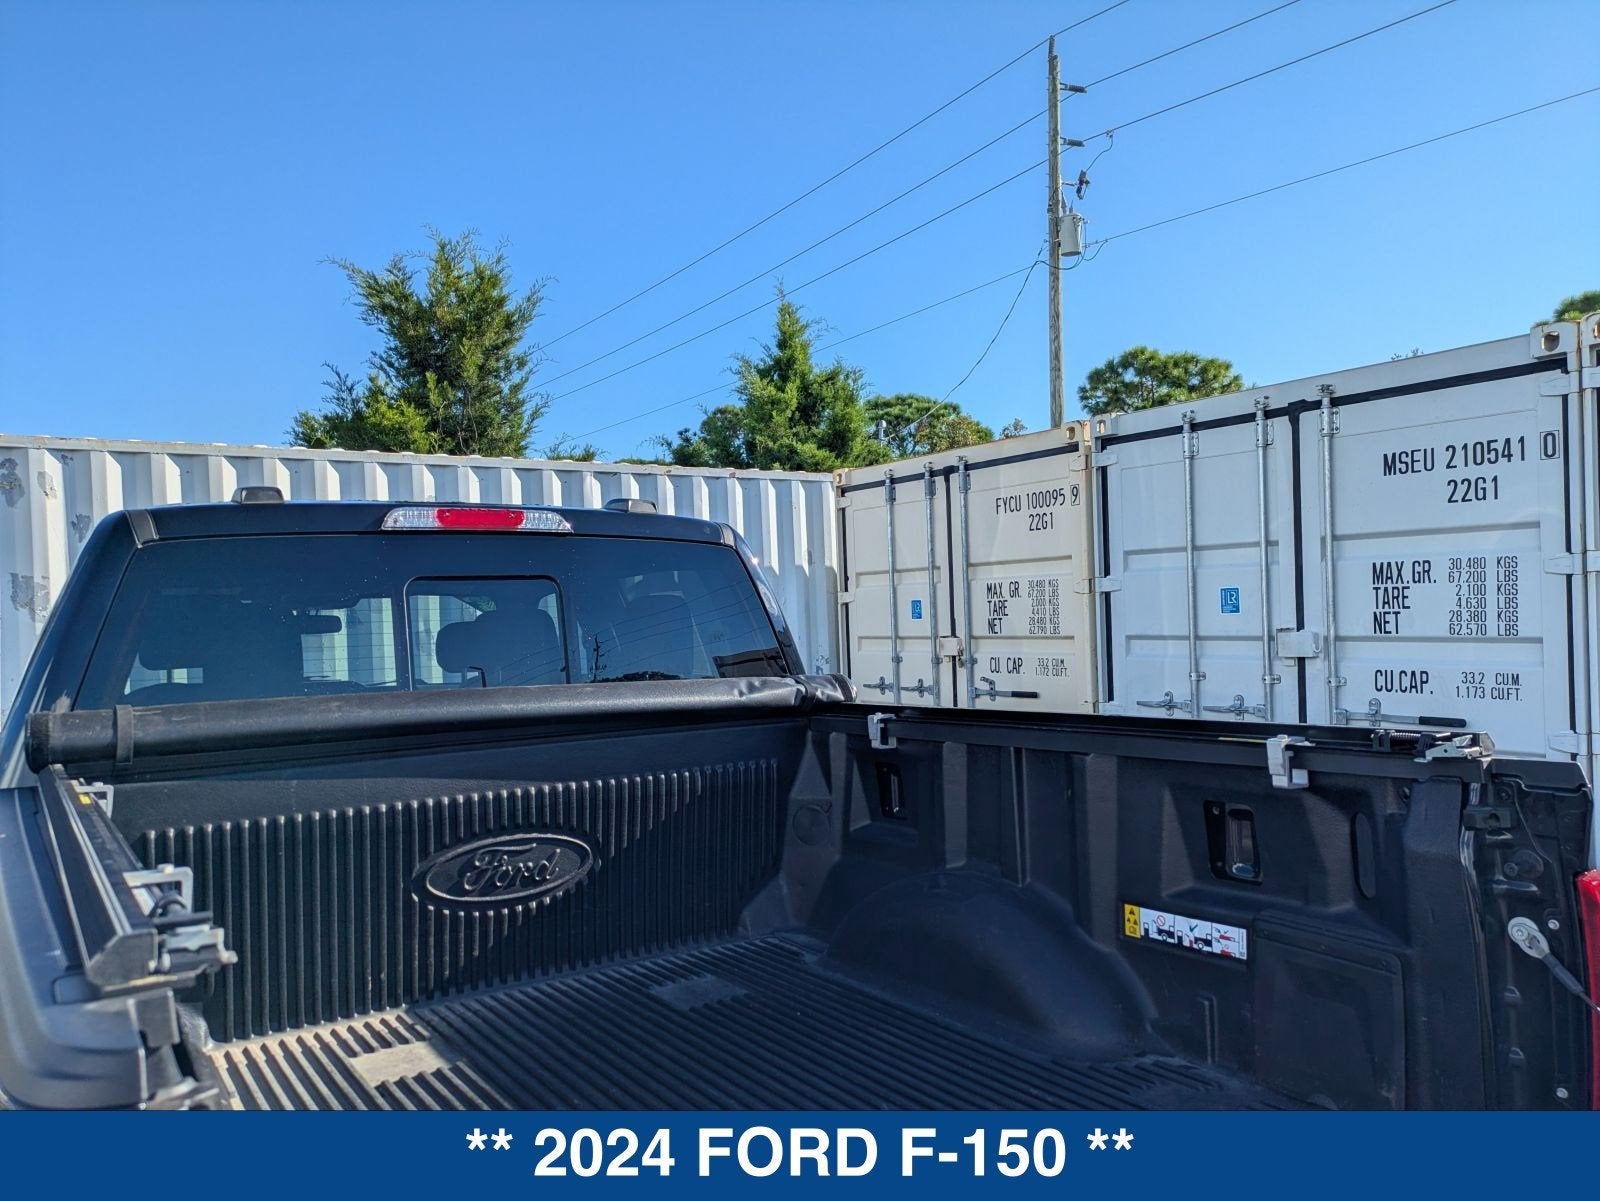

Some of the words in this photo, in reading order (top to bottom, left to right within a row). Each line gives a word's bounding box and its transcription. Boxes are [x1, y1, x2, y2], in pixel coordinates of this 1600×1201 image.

[1383, 447, 1435, 476] MSEU
[1445, 436, 1525, 470] 210541
[1543, 432, 1557, 458] 0
[1447, 475, 1499, 504] 22G1
[995, 494, 1022, 515] FYCU
[1026, 488, 1066, 510] 100095
[1071, 486, 1079, 504] 9
[1028, 512, 1054, 531] 22G1
[1448, 557, 1486, 570] 30.480
[1496, 556, 1518, 569] KGS
[1048, 579, 1059, 588] KGS
[1448, 570, 1487, 583] 67.200
[1496, 570, 1518, 583] LBS
[1048, 589, 1059, 598] LBS
[1455, 583, 1487, 597] 2.100
[1496, 583, 1519, 596] KGS
[1048, 598, 1060, 607] KGS
[1372, 586, 1411, 610] TARE
[1455, 596, 1487, 609] 4.630
[1497, 596, 1519, 609] LBS
[987, 600, 1009, 617] TARE
[1048, 607, 1060, 616] LBS
[1049, 616, 1060, 625] KGS
[1373, 611, 1401, 635] NET
[1449, 609, 1487, 623] 28.380
[1497, 609, 1519, 623] KGS
[988, 617, 1003, 635] NET
[1049, 625, 1061, 635] LBS
[1449, 623, 1487, 636] 62.570
[1497, 623, 1519, 636] LBS
[1461, 671, 1485, 685] 33.2
[1455, 686, 1485, 699] 1.173
[464, 843, 561, 896] Ford
